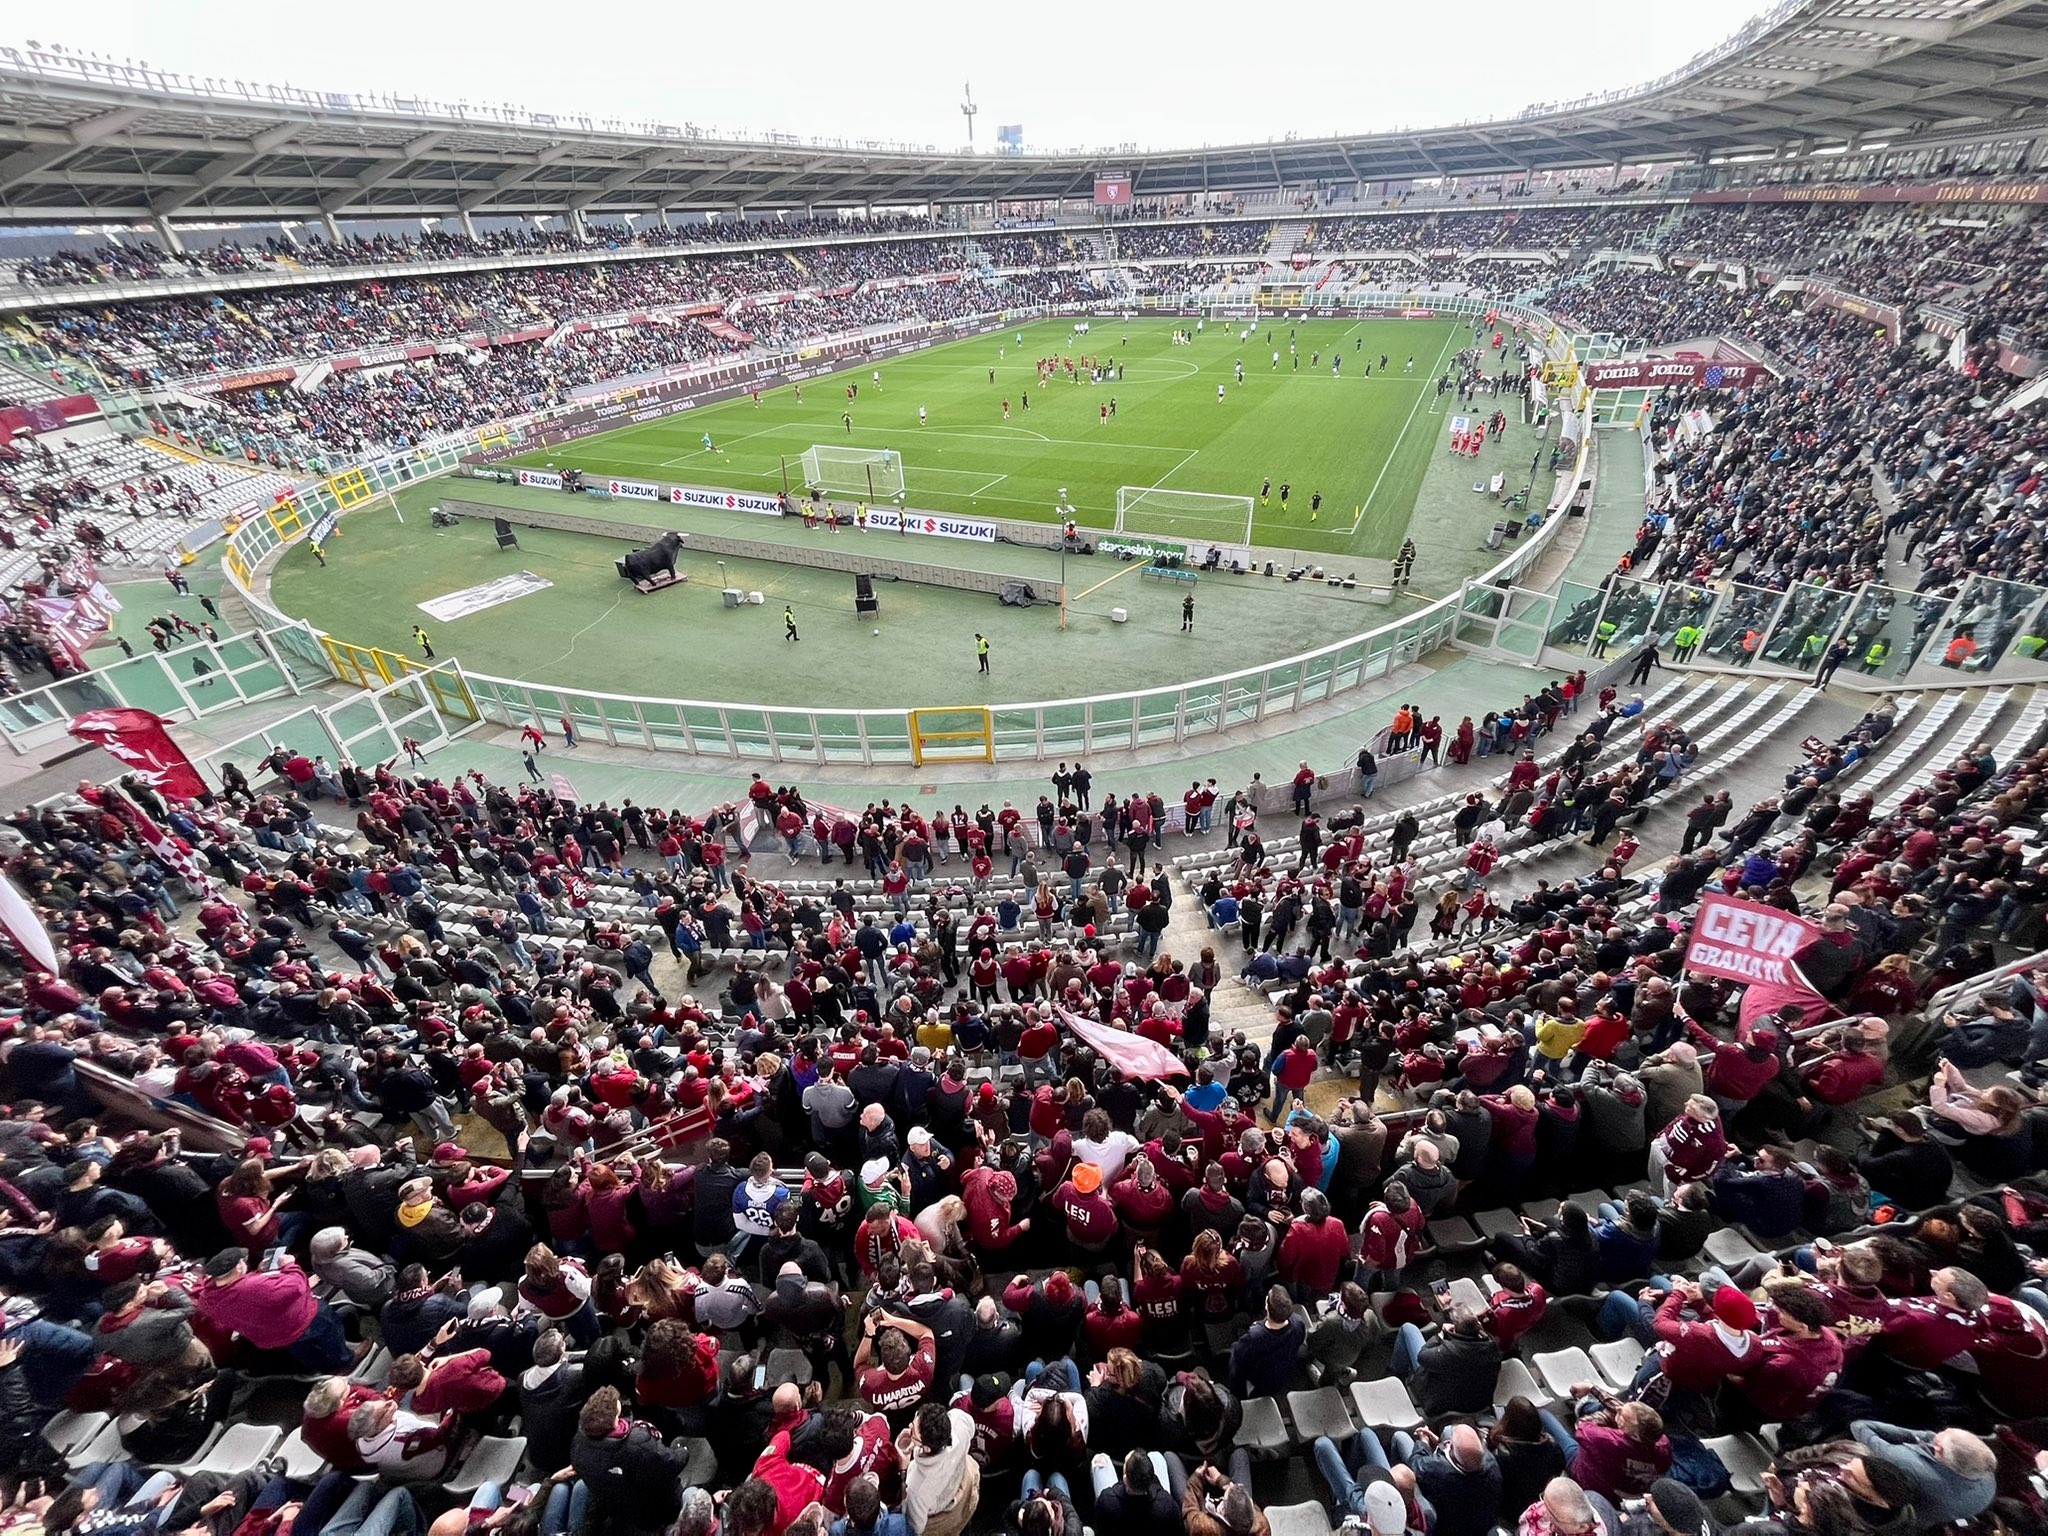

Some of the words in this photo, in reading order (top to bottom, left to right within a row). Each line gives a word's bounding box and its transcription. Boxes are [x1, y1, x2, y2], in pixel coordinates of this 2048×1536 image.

[1813, 189, 1837, 200] FORZA
[1840, 189, 1860, 200] TORO
[1936, 187, 1974, 200] STADIO
[1981, 185, 2040, 200] OLIMPICO
[361, 351, 405, 367] Beretta
[190, 382, 223, 396] TORINO
[222, 377, 254, 390] Football
[254, 374, 271, 384] Club
[595, 402, 627, 417] TORINO
[637, 395, 661, 407] ROMA
[631, 407, 663, 423] TORINO
[672, 400, 695, 413] ROMA
[529, 475, 561, 487] SUZUKI
[620, 484, 657, 498] SUZUKI
[683, 492, 723, 506] SUZUKI
[737, 498, 780, 513] SUZUKI
[870, 514, 921, 531] SUZUKI
[939, 522, 994, 539] SUZUKI
[953, 814, 965, 825] 12
[1701, 903, 1806, 958] CEVA
[746, 1207, 774, 1228] 25
[819, 1195, 851, 1224] 49
[1065, 1200, 1091, 1224] LESI
[1147, 1300, 1178, 1315] LESI
[872, 1393, 883, 1405] LA
[883, 1379, 926, 1404] MARATONA
